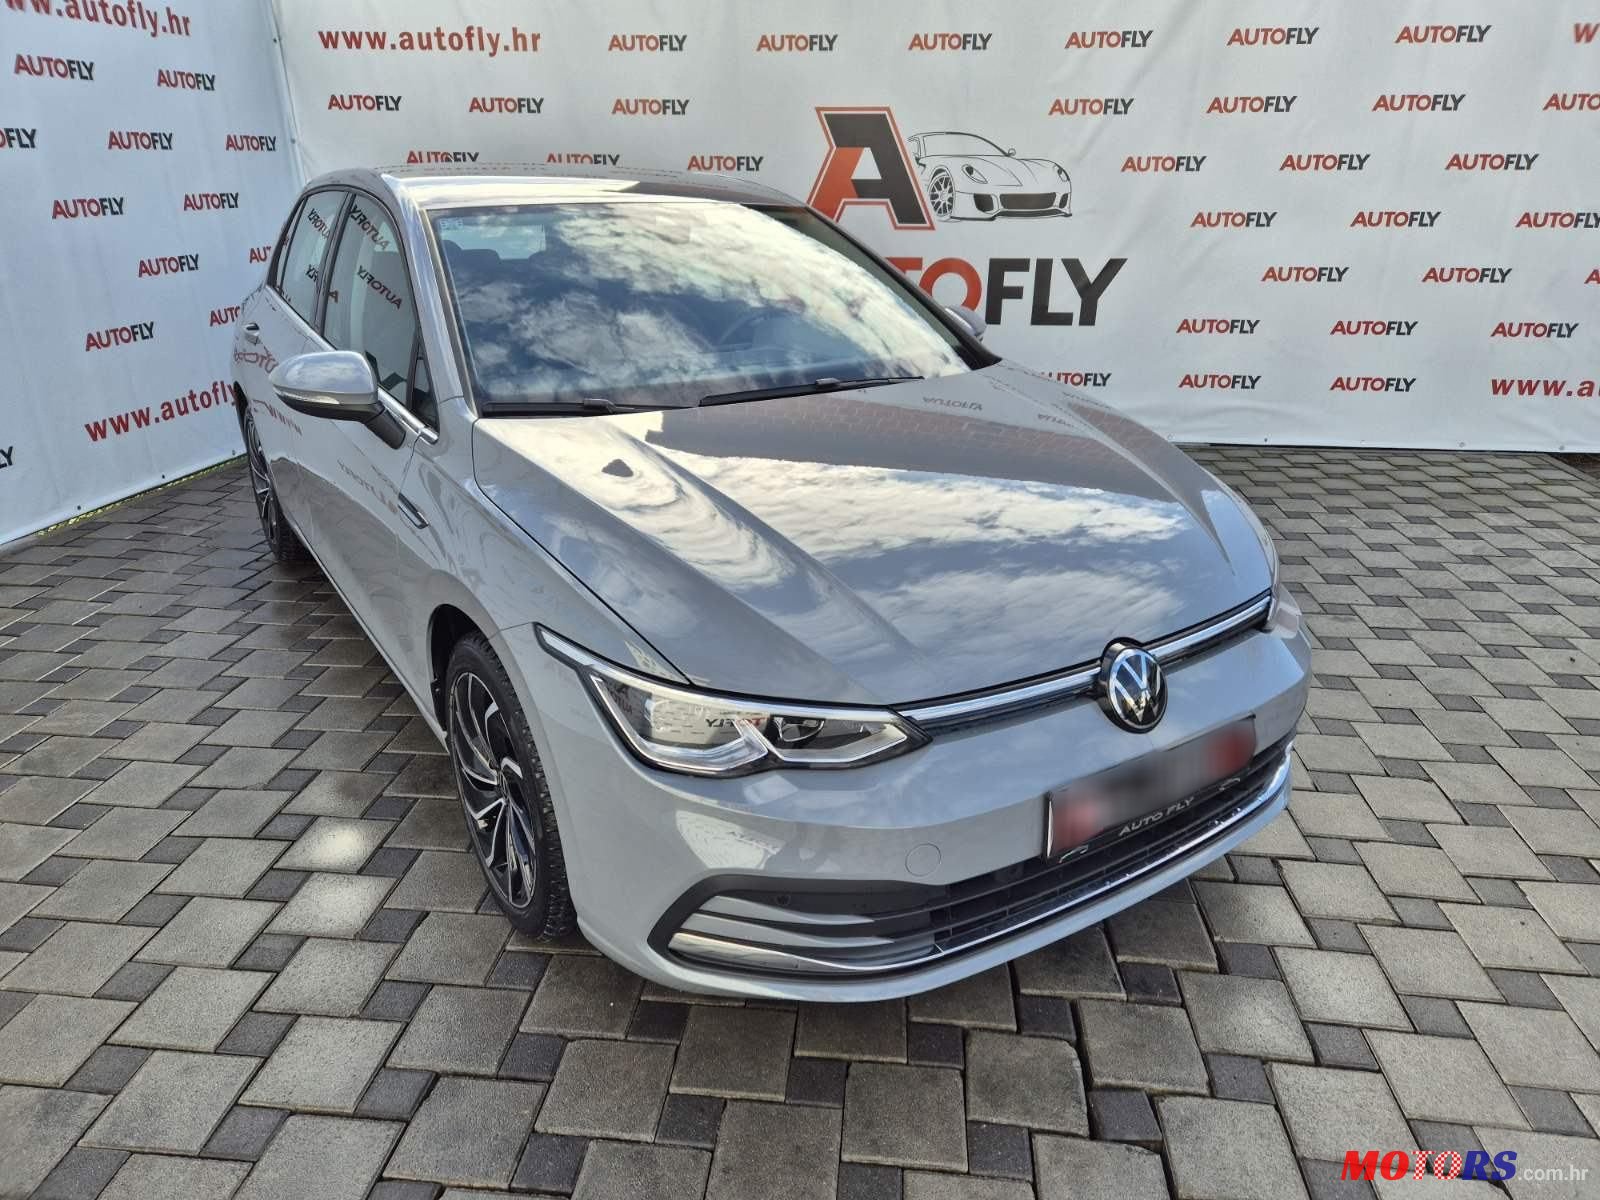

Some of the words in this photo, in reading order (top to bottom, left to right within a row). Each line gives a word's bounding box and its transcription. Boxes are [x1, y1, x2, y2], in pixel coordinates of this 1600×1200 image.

[318, 25, 540, 57] www.autofly.hr
[756, 34, 838, 51] AUTOFLY
[908, 33, 992, 50] AUTOFLY
[1064, 30, 1153, 49] AUTOFLY
[1227, 27, 1320, 46] AUTOFLY
[1395, 25, 1492, 43] AUTOFLY
[608, 35, 687, 51] AUTOFLY
[14, 54, 94, 81] AUTOFLY
[157, 69, 215, 91] AUTOFLY
[328, 94, 402, 111] AUTOFLY
[469, 97, 544, 114] AUTOFLY
[612, 99, 690, 115] AUTOFLY
[1048, 98, 1134, 115] AUTOFLY
[1206, 96, 1297, 114] AUTOFLY
[1372, 94, 1466, 112] AUTOFLY
[108, 131, 172, 150] AUTOFLY
[226, 135, 276, 151] AUTOFLY
[687, 156, 764, 171] AUTOFLY
[1121, 156, 1207, 172] AUTOFLY
[1279, 154, 1371, 171] AUTOFLY
[1445, 154, 1539, 170] AUTOFLY
[52, 197, 123, 219] AUTOFLY
[184, 192, 239, 211] AUTOFLY
[1190, 212, 1277, 227] AUTOFLY
[1350, 211, 1442, 227] AUTOFLY
[249, 246, 272, 264] AU
[138, 254, 199, 278] AUTOFLY
[1261, 267, 1349, 282] AUTOFLY
[1422, 267, 1512, 283] AUTOFLY
[1176, 319, 1260, 334] AUTOFLY
[1330, 321, 1418, 335] AUTOFLY
[1490, 322, 1579, 338] AUTOFLY
[86, 321, 154, 352] AUTOFLY
[1041, 372, 1112, 387] TOFLY
[1178, 374, 1262, 389] AUTOFLY
[1330, 377, 1416, 392] AUTOFLY
[1492, 379, 1600, 397] www.a
[1119, 811, 1163, 836] AUTO
[1166, 796, 1194, 815] FLY
